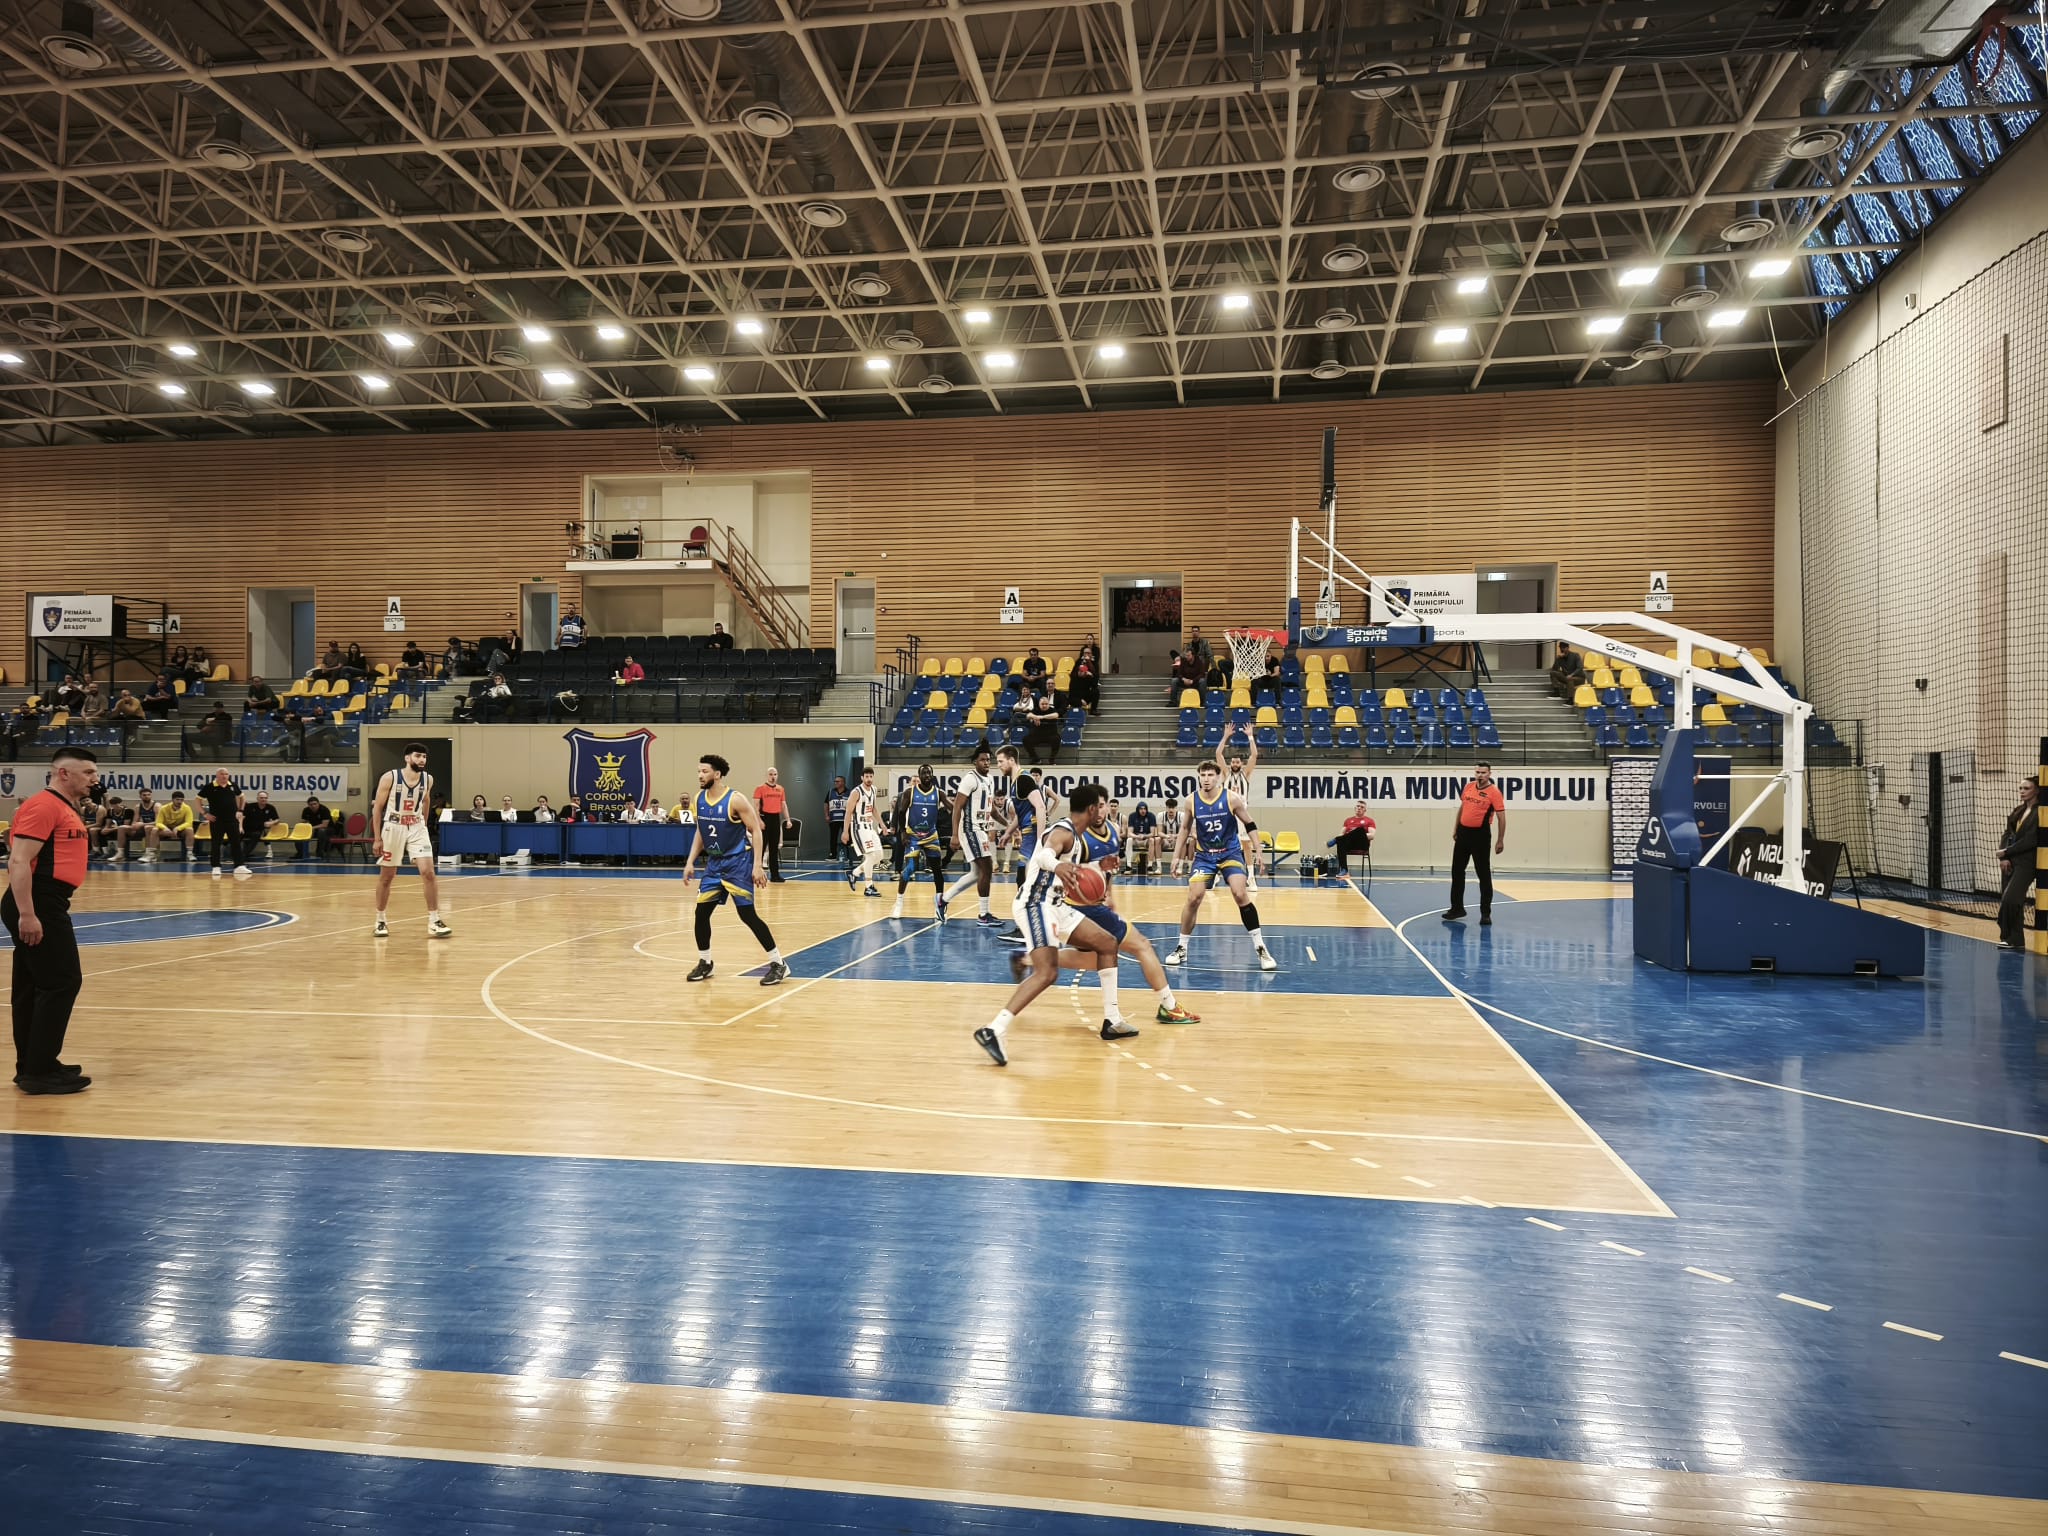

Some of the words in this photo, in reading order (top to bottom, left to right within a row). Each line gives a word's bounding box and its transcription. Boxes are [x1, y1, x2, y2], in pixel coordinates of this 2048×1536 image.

[1652, 577, 1665, 591] A
[1006, 592, 1018, 605] A
[1413, 589, 1450, 598] PRIMĂRIA
[389, 601, 400, 614] A
[1413, 598, 1464, 606] MUNICIPIULUI
[169, 619, 179, 632] A
[1346, 628, 1388, 636] Schelde
[1346, 635, 1388, 644] Sports
[1114, 775, 1200, 799] BRASO
[1266, 771, 1397, 800] PRIMĂRIA
[1405, 776, 1595, 801] MUNIPIULUI
[682, 811, 691, 823] 2
[921, 807, 929, 817] 3
[708, 824, 718, 837] 2
[1204, 819, 1223, 832] 25
[1757, 842, 1812, 869] Maur
